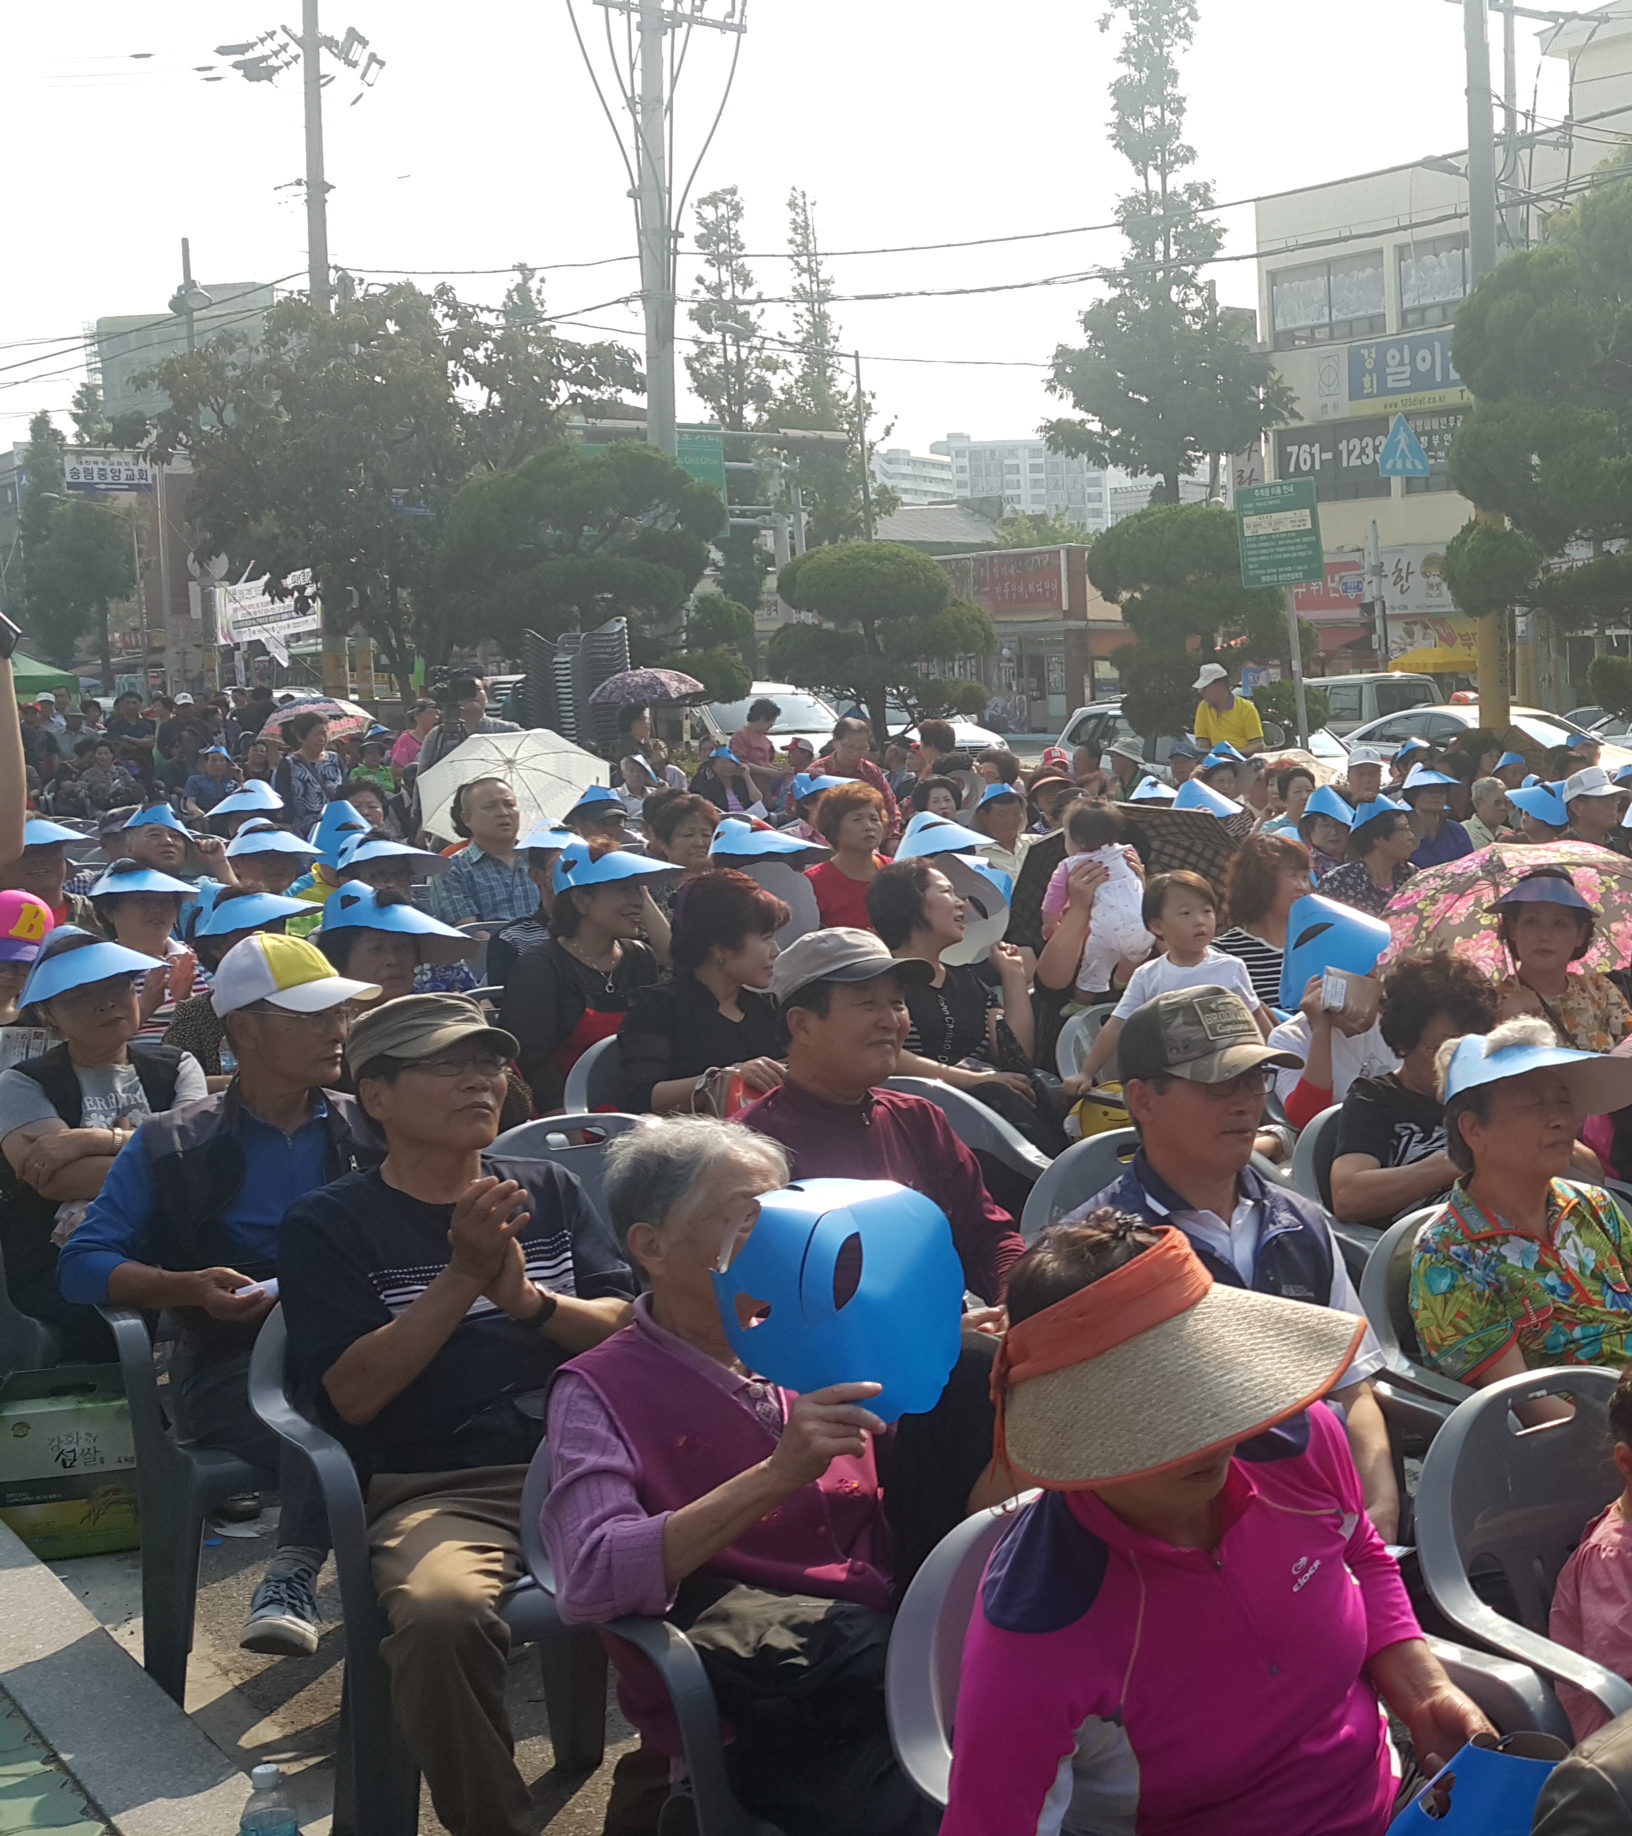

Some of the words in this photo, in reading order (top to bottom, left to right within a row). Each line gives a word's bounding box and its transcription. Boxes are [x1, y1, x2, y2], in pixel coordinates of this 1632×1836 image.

[1385, 340, 1460, 389] 일이
[69, 466, 149, 482] 송림중앙교회
[9, 903, 47, 941] B
